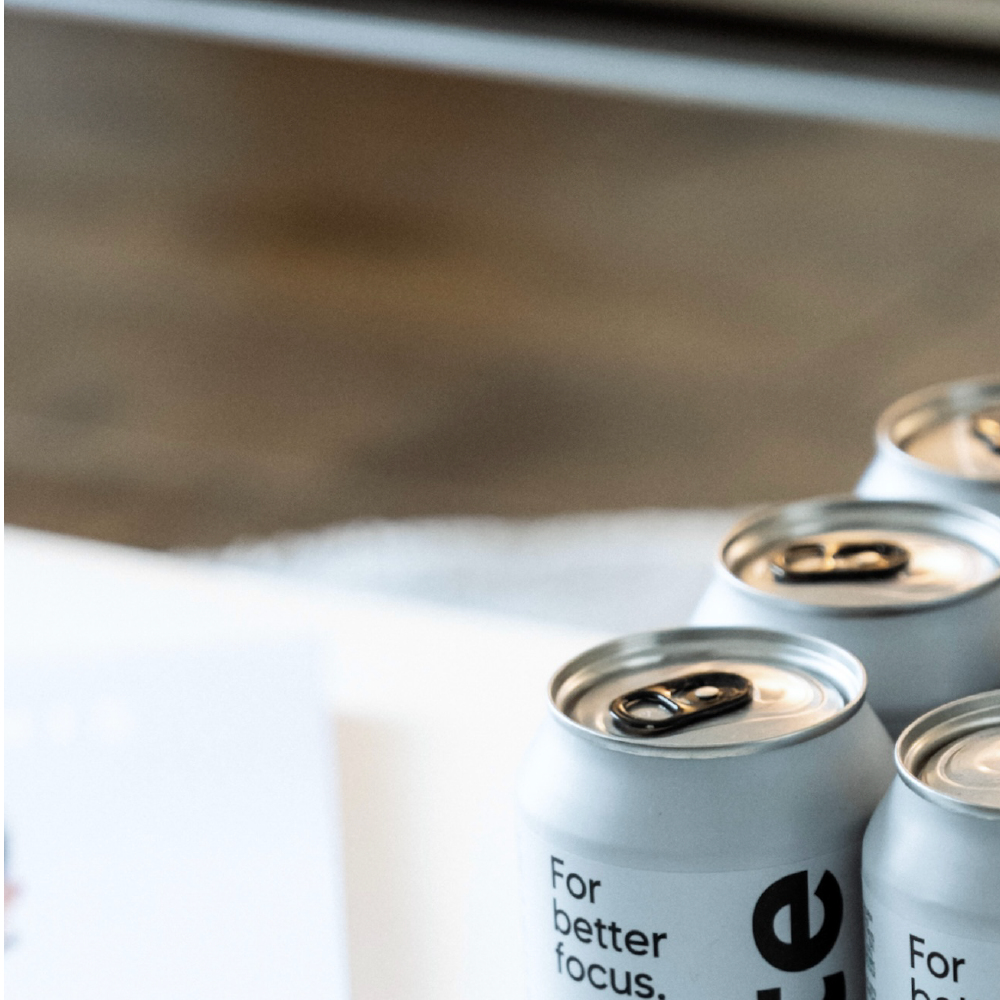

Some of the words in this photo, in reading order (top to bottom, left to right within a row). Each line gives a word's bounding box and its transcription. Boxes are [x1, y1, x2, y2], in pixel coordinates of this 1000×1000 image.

[551, 855, 601, 904] For
[553, 898, 667, 958] better
[555, 941, 666, 1000] focus.
[909, 933, 965, 983] For
